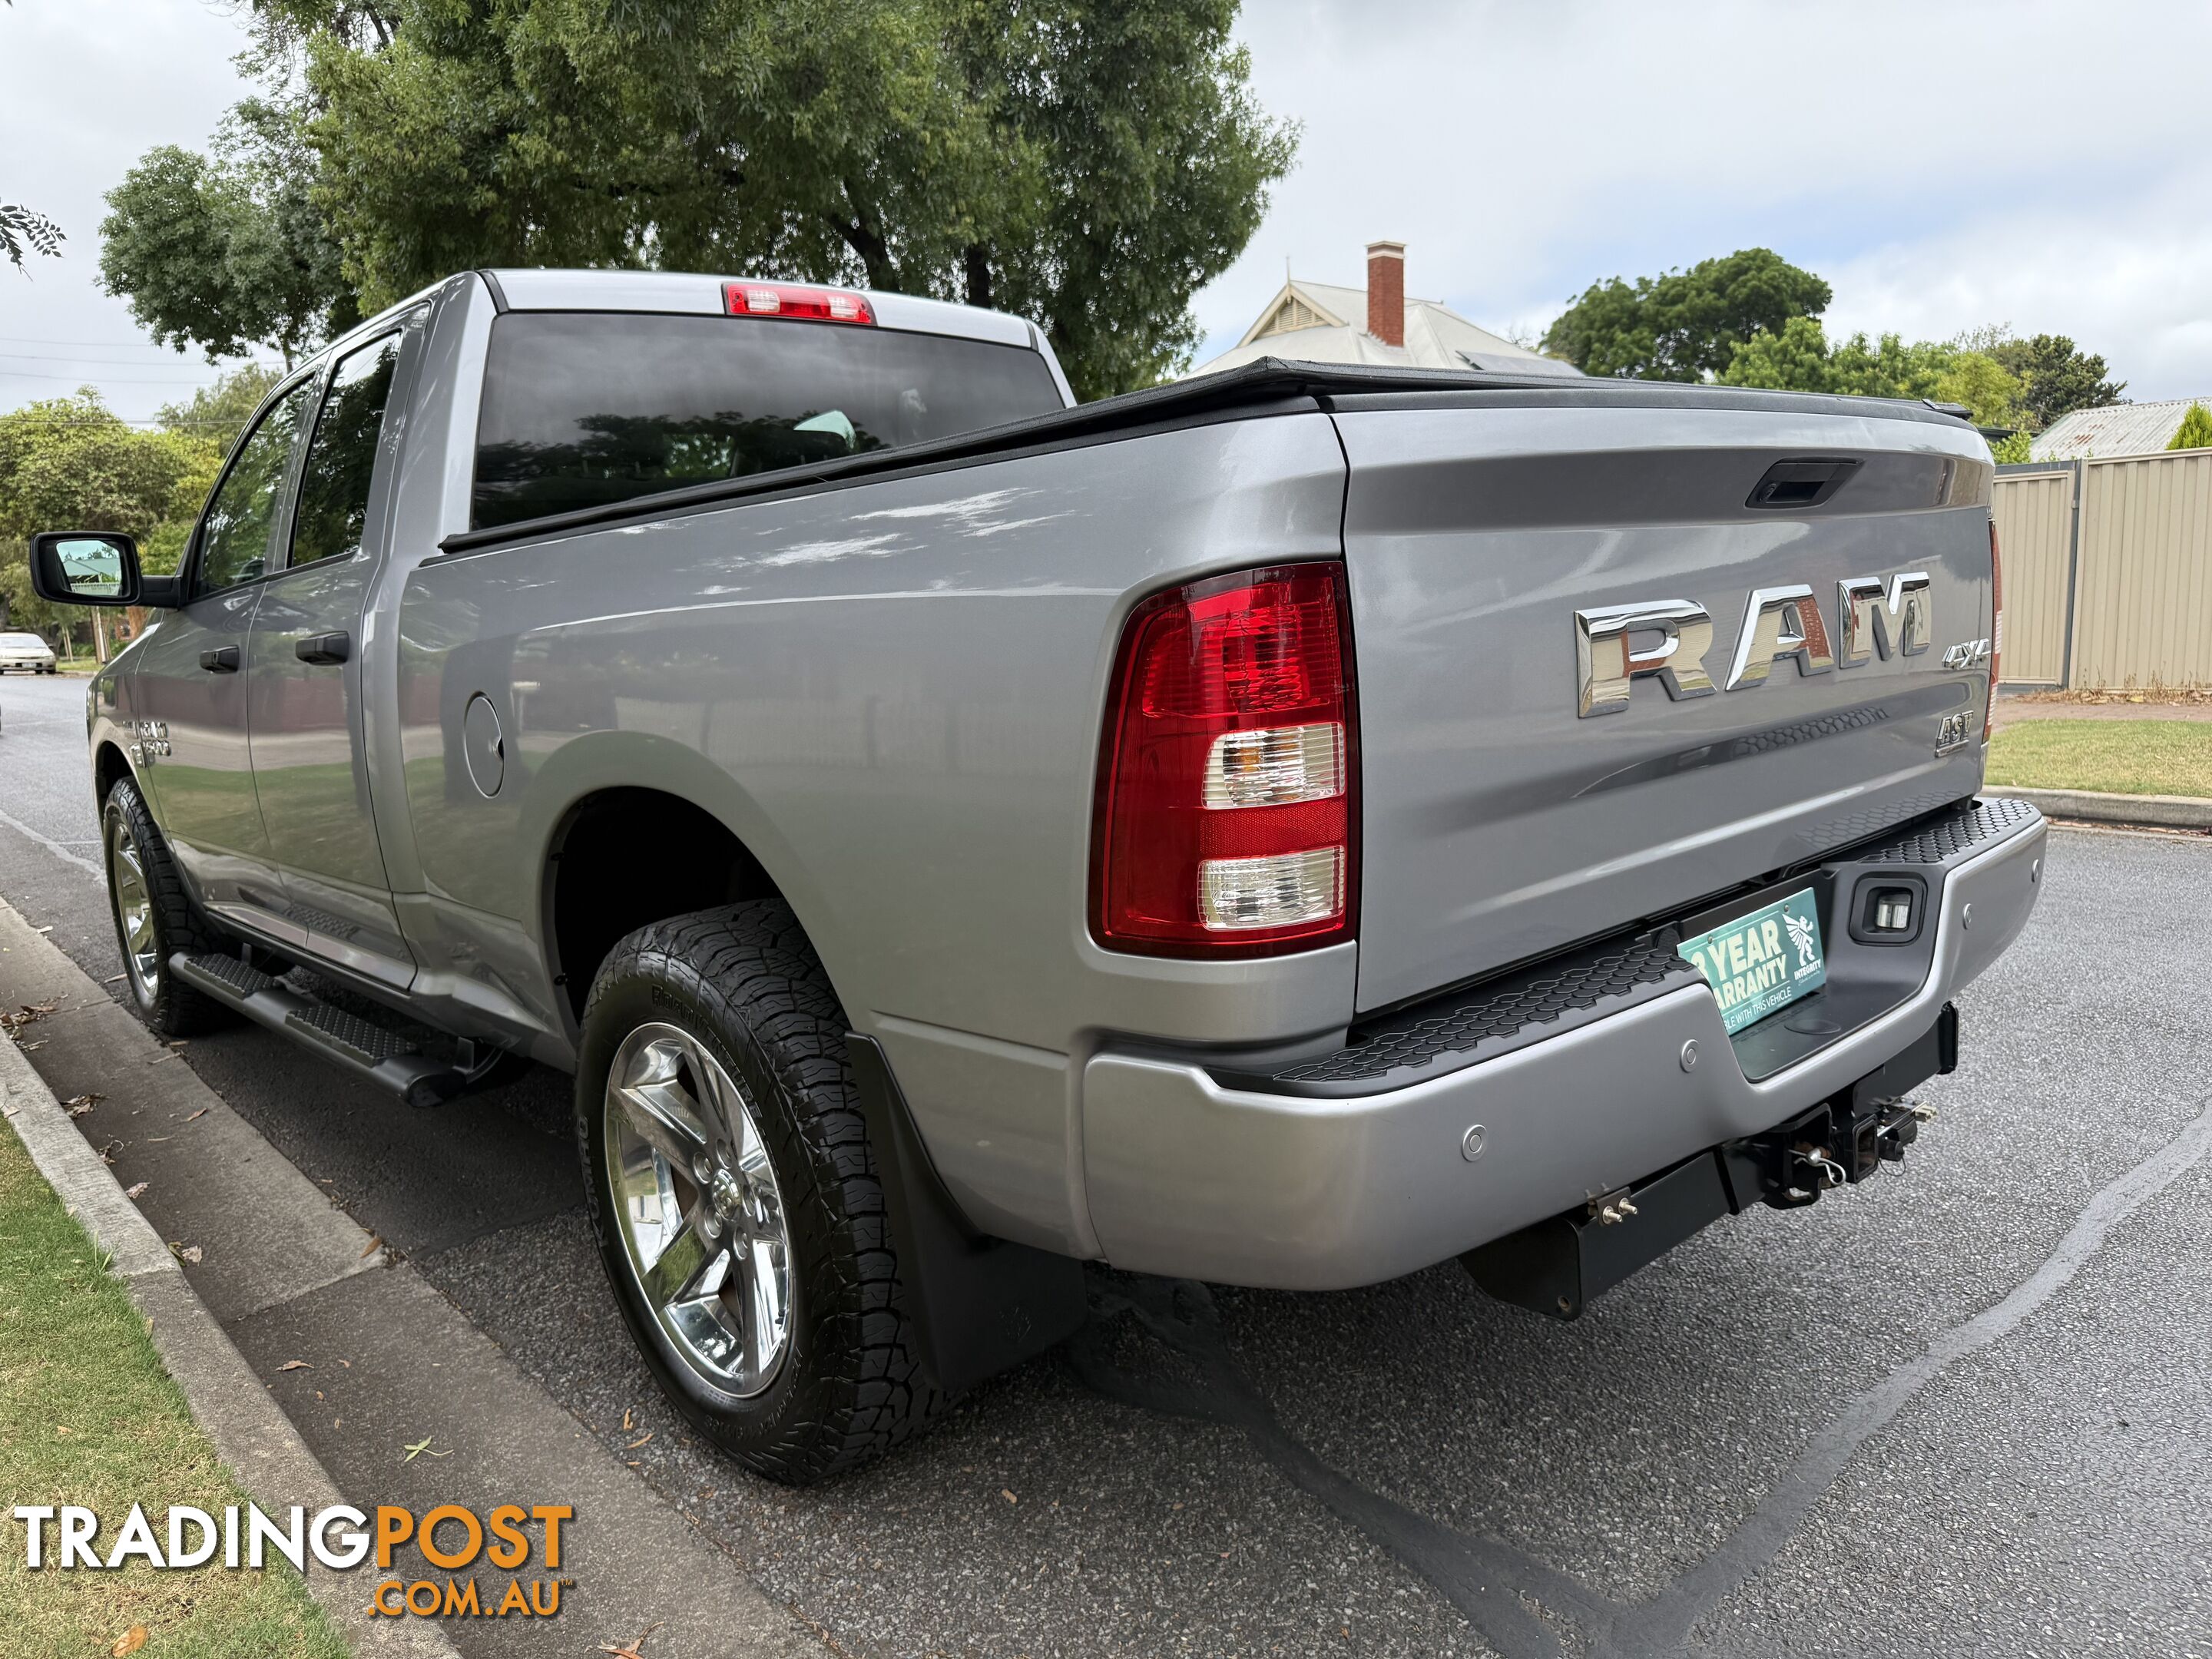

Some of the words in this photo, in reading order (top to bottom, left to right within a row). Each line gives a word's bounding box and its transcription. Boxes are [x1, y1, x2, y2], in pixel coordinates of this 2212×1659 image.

[1574, 571, 1931, 719] RAM
[1707, 919, 1783, 982] YEAR
[1794, 959, 1820, 980] INTEGRITY
[1736, 1007, 1752, 1023] WITH
[1752, 1000, 1767, 1015] THIS
[1767, 986, 1792, 1007] VEHICLE
